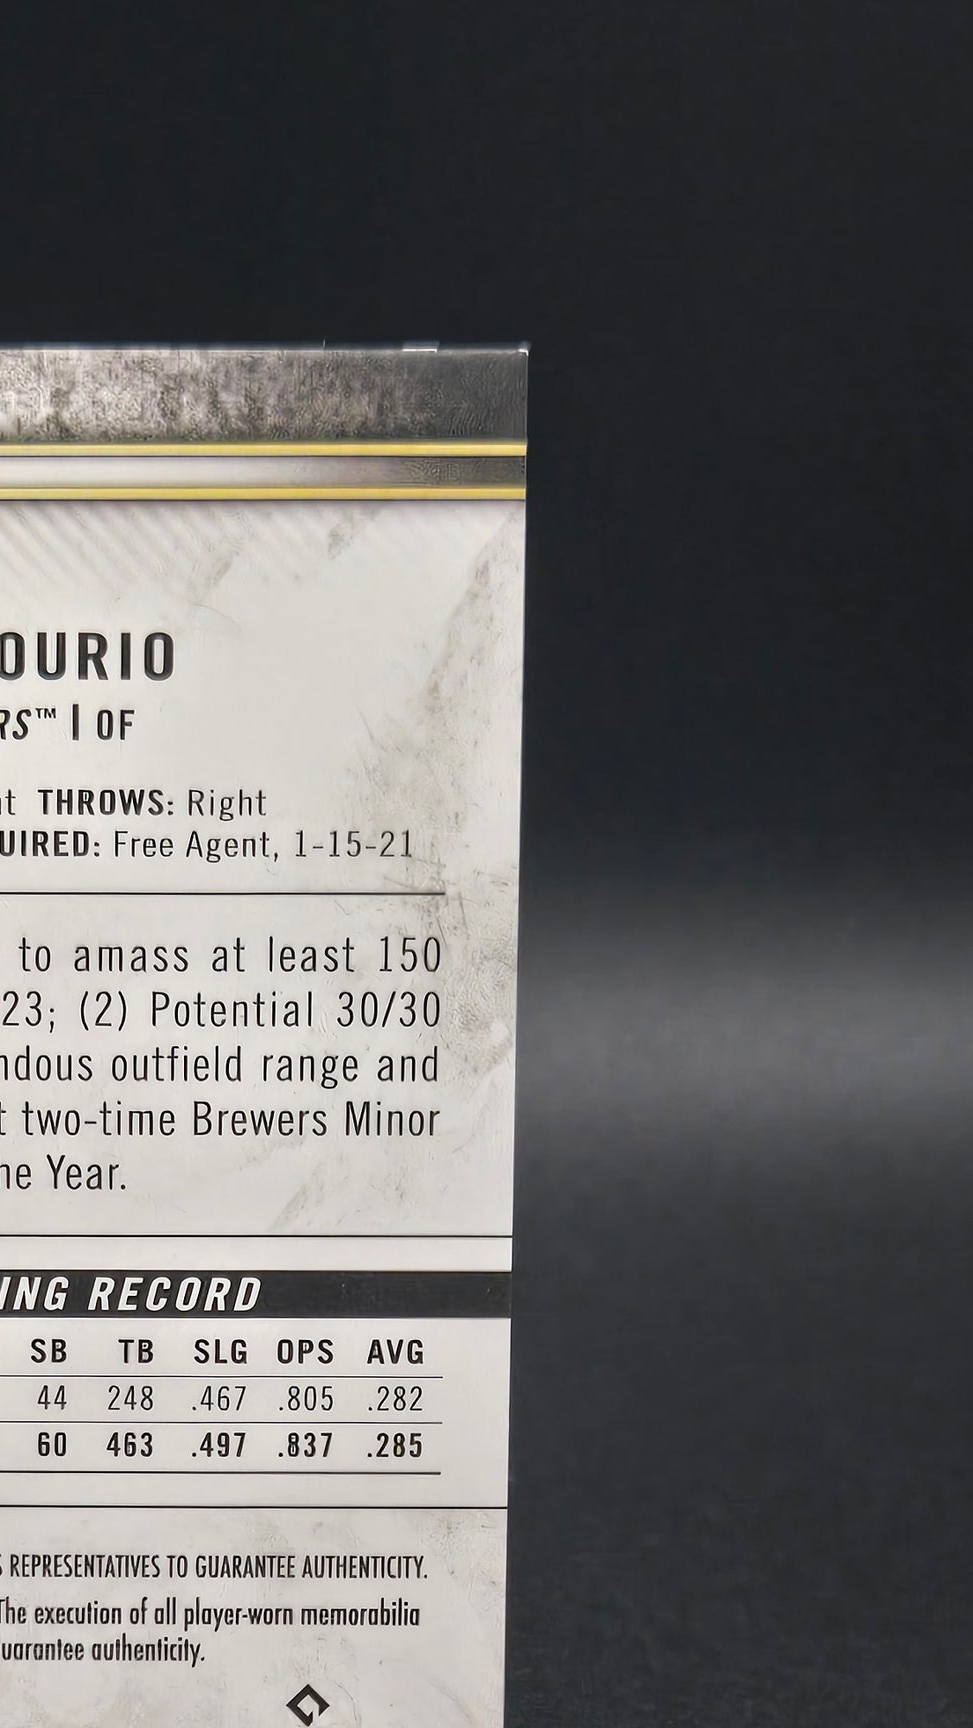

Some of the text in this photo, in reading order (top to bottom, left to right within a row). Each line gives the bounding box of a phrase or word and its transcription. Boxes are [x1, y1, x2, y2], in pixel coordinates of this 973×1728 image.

[97, 710, 134, 740] OF
[38, 789, 173, 815] THROWS:
[189, 789, 266, 821] Right
[115, 831, 173, 857] Free
[186, 831, 278, 863] Agent,
[296, 830, 411, 857] 1-15-21
[19, 937, 50, 972] to
[74, 947, 188, 972] amass
[212, 938, 245, 972] at
[269, 936, 354, 972] least
[380, 936, 440, 972] 150
[112, 1045, 241, 1081] outfield
[263, 1055, 358, 1089] range
[378, 1046, 437, 1082] and
[88, 1277, 260, 1312] RECORD
[31, 1338, 66, 1363] SB
[118, 1339, 153, 1363] TB
[194, 1339, 247, 1364] SLG
[278, 1339, 333, 1364] OPS
[367, 1339, 423, 1365] AVG
[38, 1432, 66, 1456] 60
[107, 1432, 152, 1458] 463
[192, 1432, 246, 1457] .497
[279, 1433, 332, 1458] .837
[368, 1433, 422, 1457] .285
[10, 1554, 160, 1578] REPRESENTATIVES
[167, 1555, 188, 1578] TO
[196, 1555, 295, 1579] GUARANTEE
[302, 1556, 427, 1579] AUTHENTICITY.
[35, 1601, 121, 1624] execution
[130, 1597, 147, 1624] of
[155, 1597, 176, 1625] all
[184, 1597, 293, 1632] player-worn
[301, 1597, 419, 1625] memorabilia
